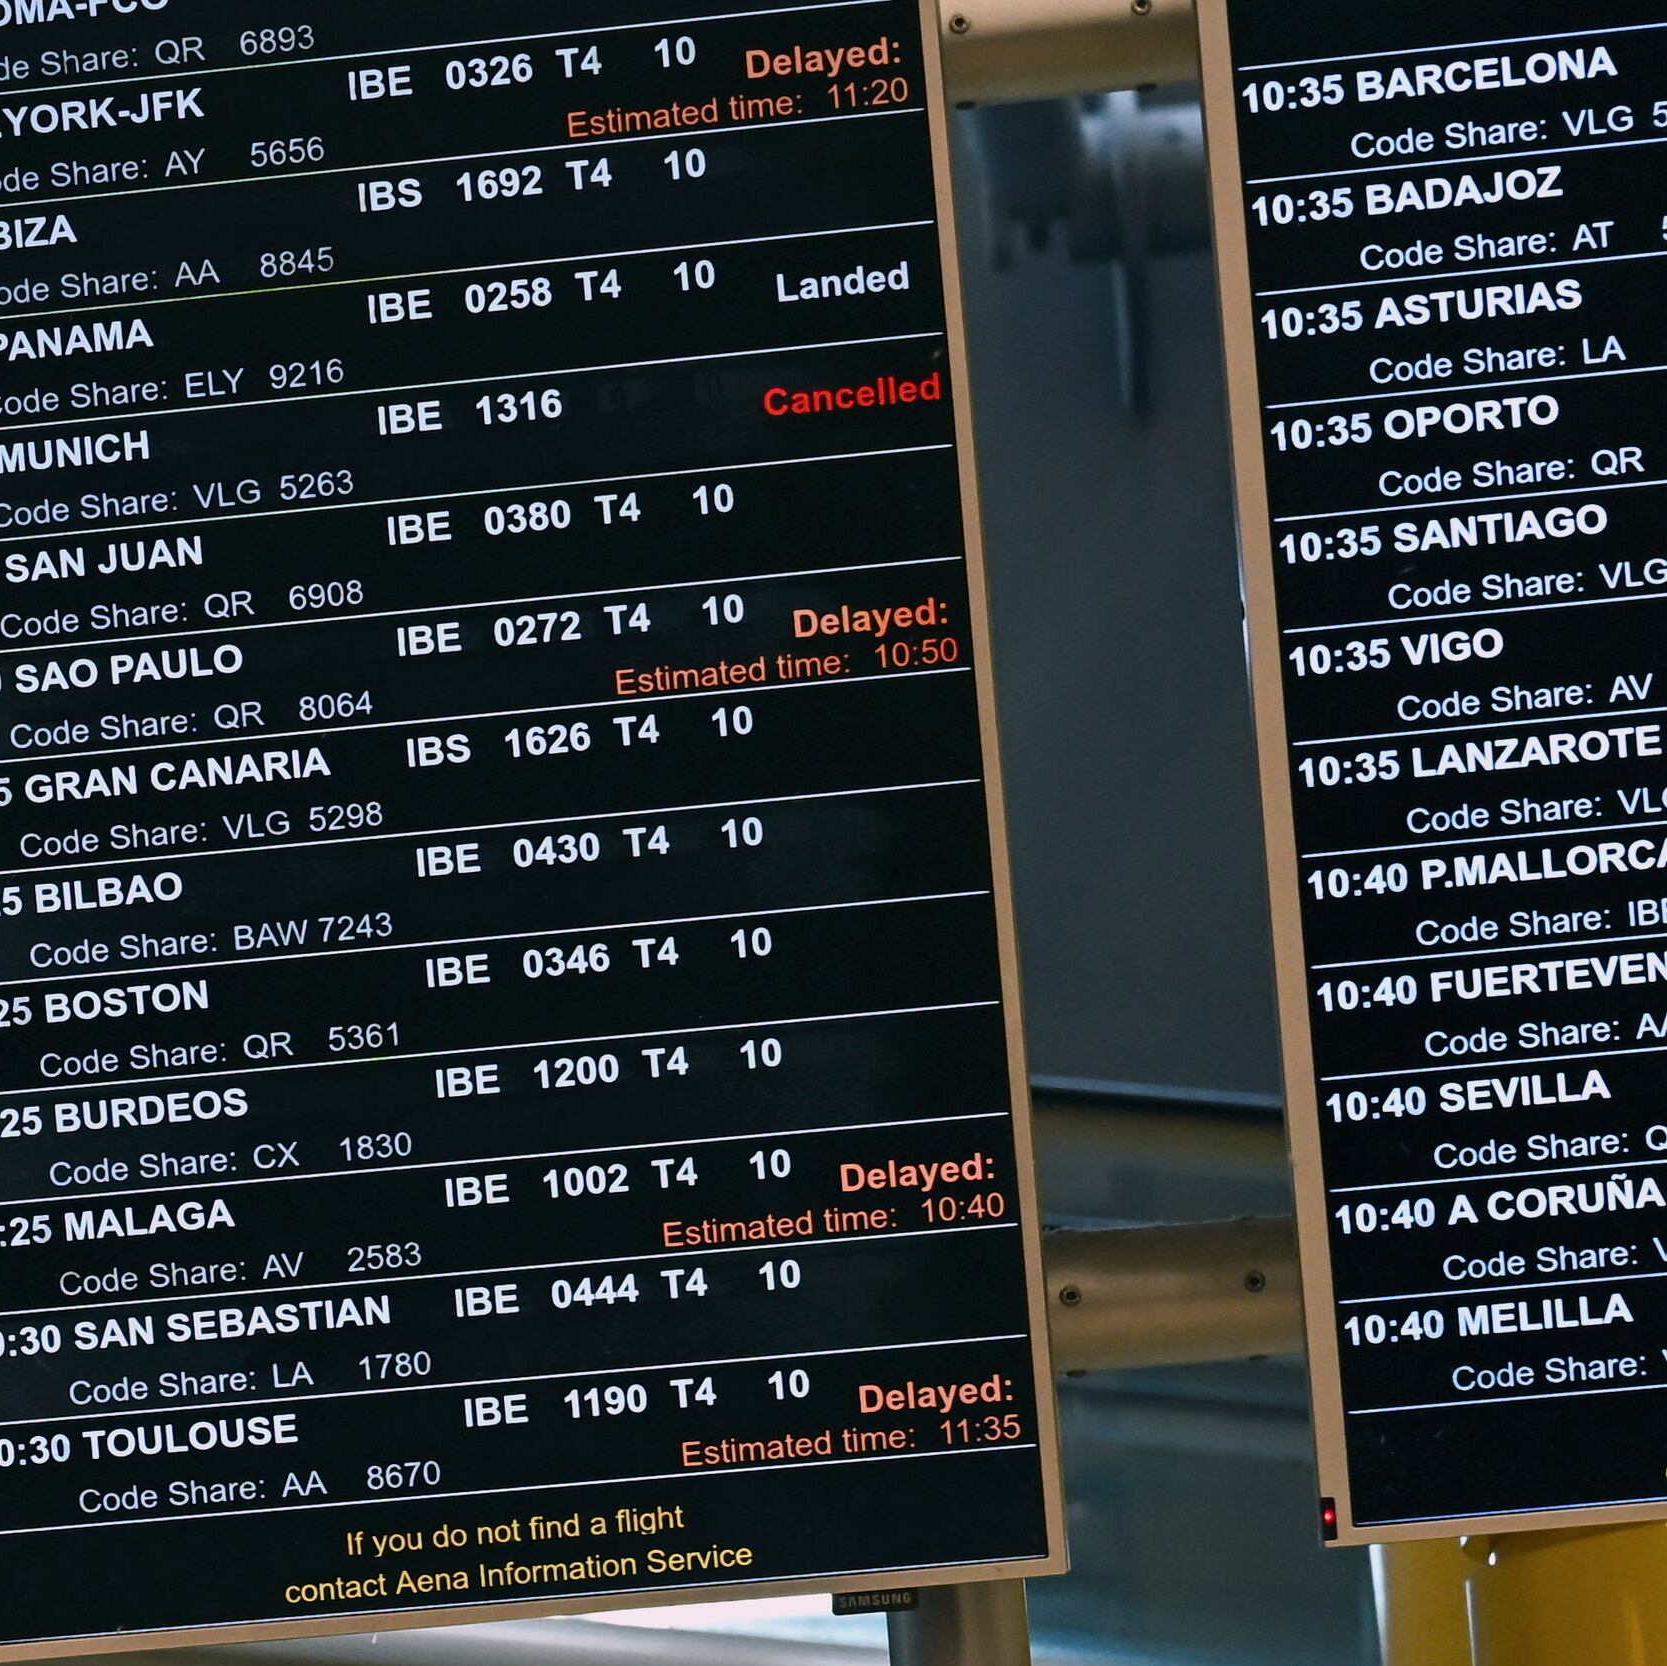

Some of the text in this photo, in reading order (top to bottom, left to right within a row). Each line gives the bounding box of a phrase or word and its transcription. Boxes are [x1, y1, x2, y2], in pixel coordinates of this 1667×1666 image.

[348, 64, 413, 101] IBE
[445, 53, 534, 90] 0326
[554, 45, 603, 78] T4
[654, 35, 696, 68] 10
[745, 36, 901, 79] Delayed:
[50, 160, 148, 188] Share:
[164, 147, 206, 177] AY
[250, 136, 325, 168] 5656
[1251, 165, 1564, 227] 10:35 BADAJOZ
[1359, 220, 1615, 271] Code Share: AT
[367, 288, 433, 325] IBE
[464, 277, 553, 314] 0258
[574, 268, 622, 302] T4
[673, 259, 716, 292] 10
[776, 260, 910, 303] Landed
[1279, 503, 1608, 565] 10:35 SANTIAGO
[1325, 1069, 1612, 1123] 10:40 SEVILLA
[1344, 1292, 1635, 1346] 10:40 MELILLA
[285, 1547, 753, 1604] contact Aena Information Service
[839, 1592, 912, 1608] SAMSUNG
